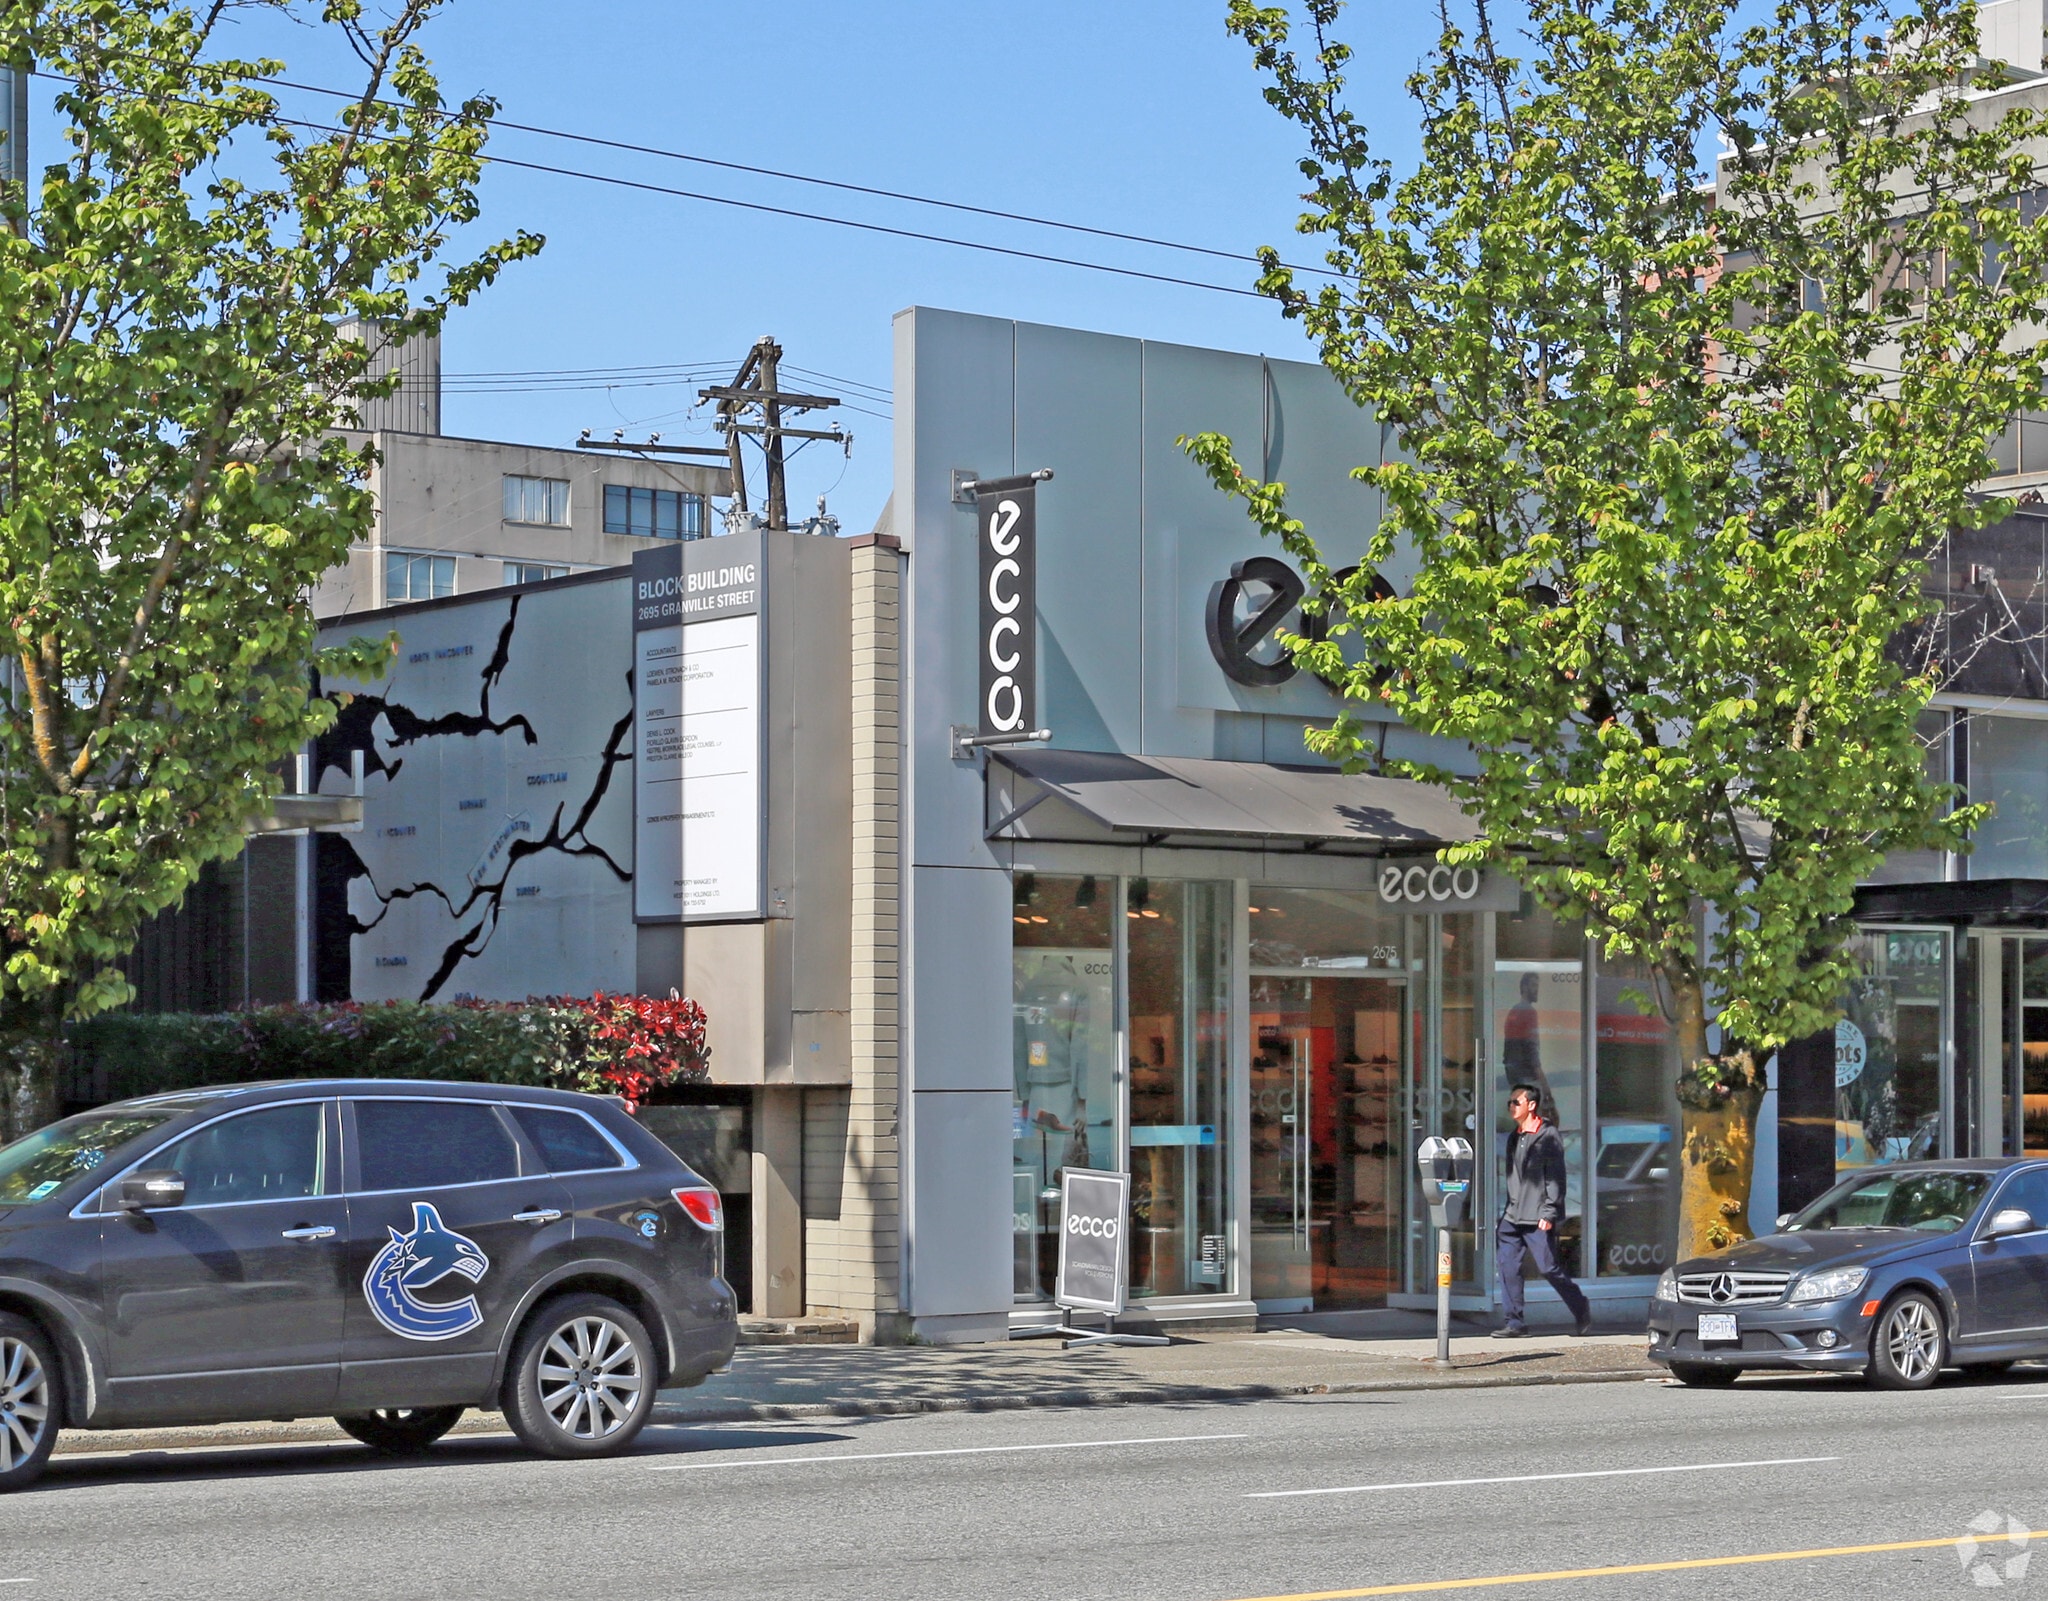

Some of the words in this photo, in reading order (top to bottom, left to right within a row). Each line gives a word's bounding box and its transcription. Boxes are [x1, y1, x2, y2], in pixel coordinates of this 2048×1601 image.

[638, 576, 684, 600] BLOCK
[688, 563, 755, 592] BUILDING
[638, 605, 659, 620] 2695
[661, 596, 715, 616] GRANVILLE
[717, 590, 755, 608] STREET
[988, 500, 1023, 732] ecco
[646, 646, 676, 656] ACCOUNTANTS
[1380, 866, 1479, 902] ecco
[1373, 946, 1397, 959] 2675
[1552, 972, 1581, 983] ecco
[1068, 1214, 1117, 1239] ecco
[1609, 1244, 1666, 1265] ecco
